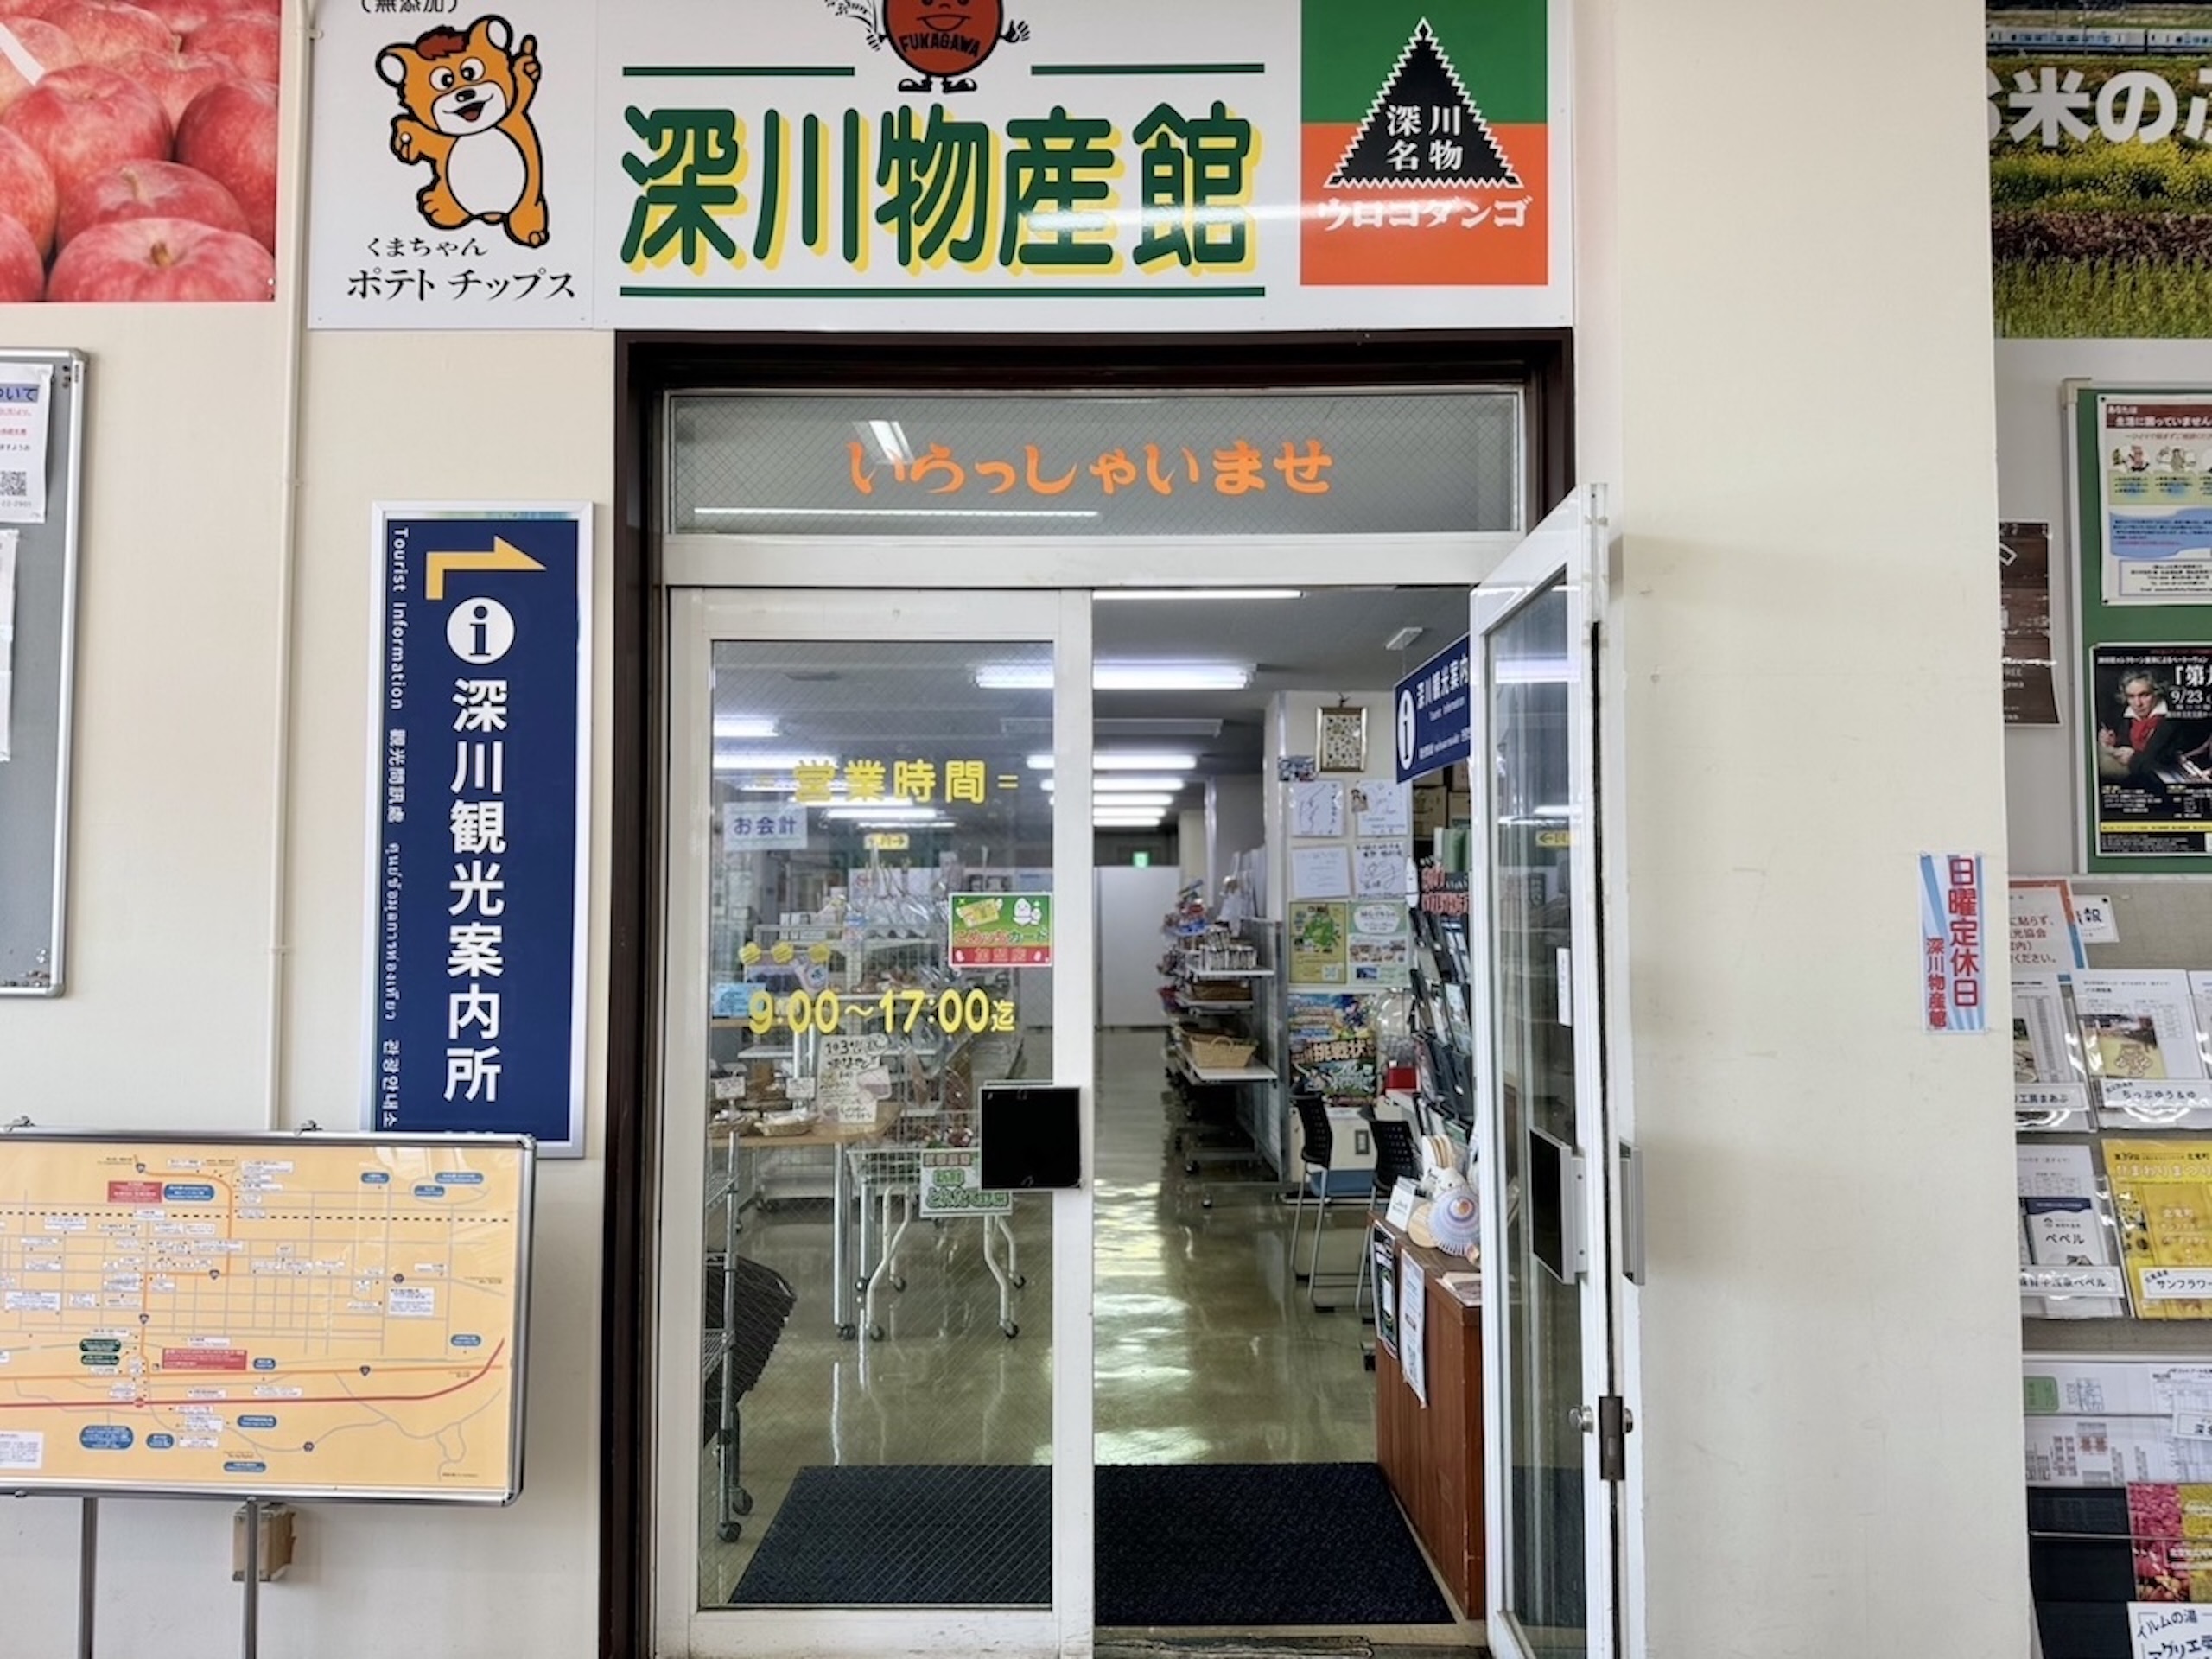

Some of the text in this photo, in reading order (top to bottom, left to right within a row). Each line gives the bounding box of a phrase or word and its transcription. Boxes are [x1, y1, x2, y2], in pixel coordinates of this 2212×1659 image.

[899, 35, 981, 59] FUKAGAWA
[1385, 104, 1462, 137] 深川
[1987, 67, 2212, 147] 米の
[1386, 140, 1464, 172] 名物
[620, 100, 1255, 270] 深川物産館
[1318, 195, 1534, 231] ウロコダンゴ
[367, 237, 489, 258] くまちゃん
[347, 269, 576, 302] ポテト チップス
[845, 440, 1333, 496] いらっしゃいませ
[390, 527, 410, 709] Tourist Information
[792, 759, 986, 803] 営業時間
[734, 816, 798, 836] お会計
[443, 678, 509, 1103] 深川観光案内所
[1948, 858, 1979, 1007] 日曜定休日
[2010, 927, 2047, 939] 光協会
[2075, 906, 2102, 925] 報
[381, 1039, 400, 1128] 관광안내소
